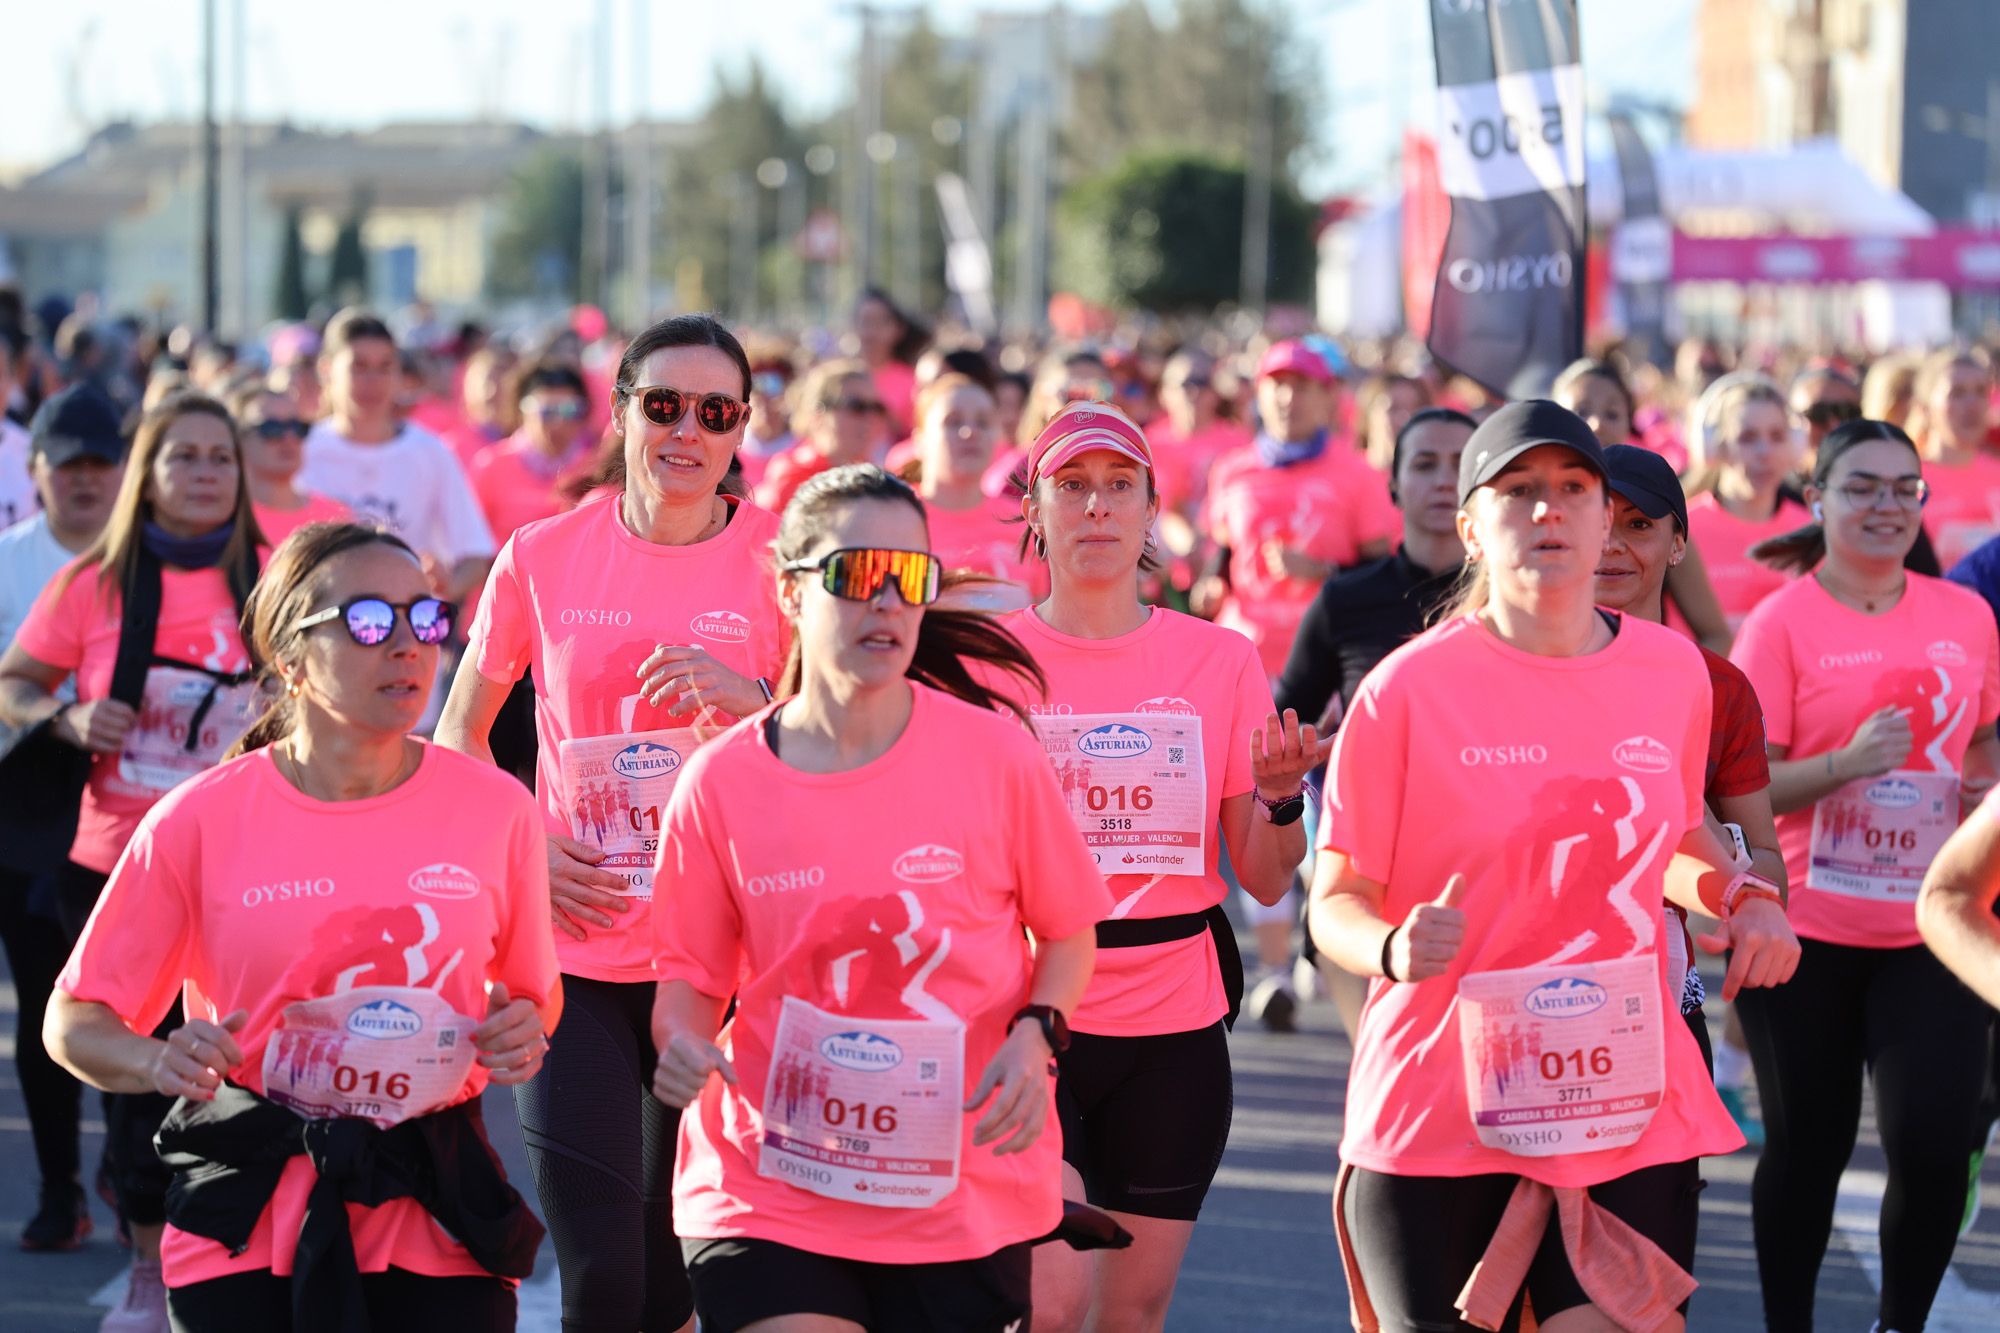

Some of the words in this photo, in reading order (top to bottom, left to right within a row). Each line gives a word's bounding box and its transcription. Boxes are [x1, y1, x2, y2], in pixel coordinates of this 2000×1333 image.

[1076, 412, 1094, 422] Buff
[560, 608, 632, 627] OYSHO
[998, 704, 1073, 719] OSHO
[170, 724, 218, 748] 06
[1083, 737, 1147, 750] ASTURIANA
[1045, 744, 1070, 754] UMA
[1460, 744, 1548, 767] OYSHO
[575, 767, 608, 778] SUMA
[619, 757, 676, 771] ASTURIANA
[1087, 785, 1153, 811] 016
[630, 806, 660, 831] 01
[1100, 818, 1132, 830] 3518
[1087, 835, 1098, 844] DE
[1100, 835, 1111, 844] LA
[1112, 834, 1140, 843] MUJER
[1147, 834, 1183, 843] VALENCIA
[1865, 829, 1916, 849] 016
[1136, 854, 1184, 865] Santander
[747, 866, 825, 897] OYSHO
[242, 877, 335, 908] OYSHO
[1532, 993, 1602, 1011] ASTURIANA
[353, 1013, 416, 1032] ASTURIANA
[826, 1041, 898, 1064] ASTURIANA
[1540, 1046, 1613, 1080] 016
[333, 1065, 411, 1100] 016
[1558, 1086, 1592, 1102] 3771
[344, 1102, 381, 1115] 3770
[823, 1097, 898, 1133] 016
[1498, 1111, 1541, 1123] CARRERA
[1543, 1109, 1557, 1120] DE
[1559, 1107, 1572, 1118] LA
[1573, 1104, 1604, 1116] MUJER
[1608, 1098, 1646, 1112] VALENCIA
[836, 1136, 870, 1152] 3769
[777, 1157, 832, 1185] OYSHO
[870, 1181, 932, 1197] Santander
